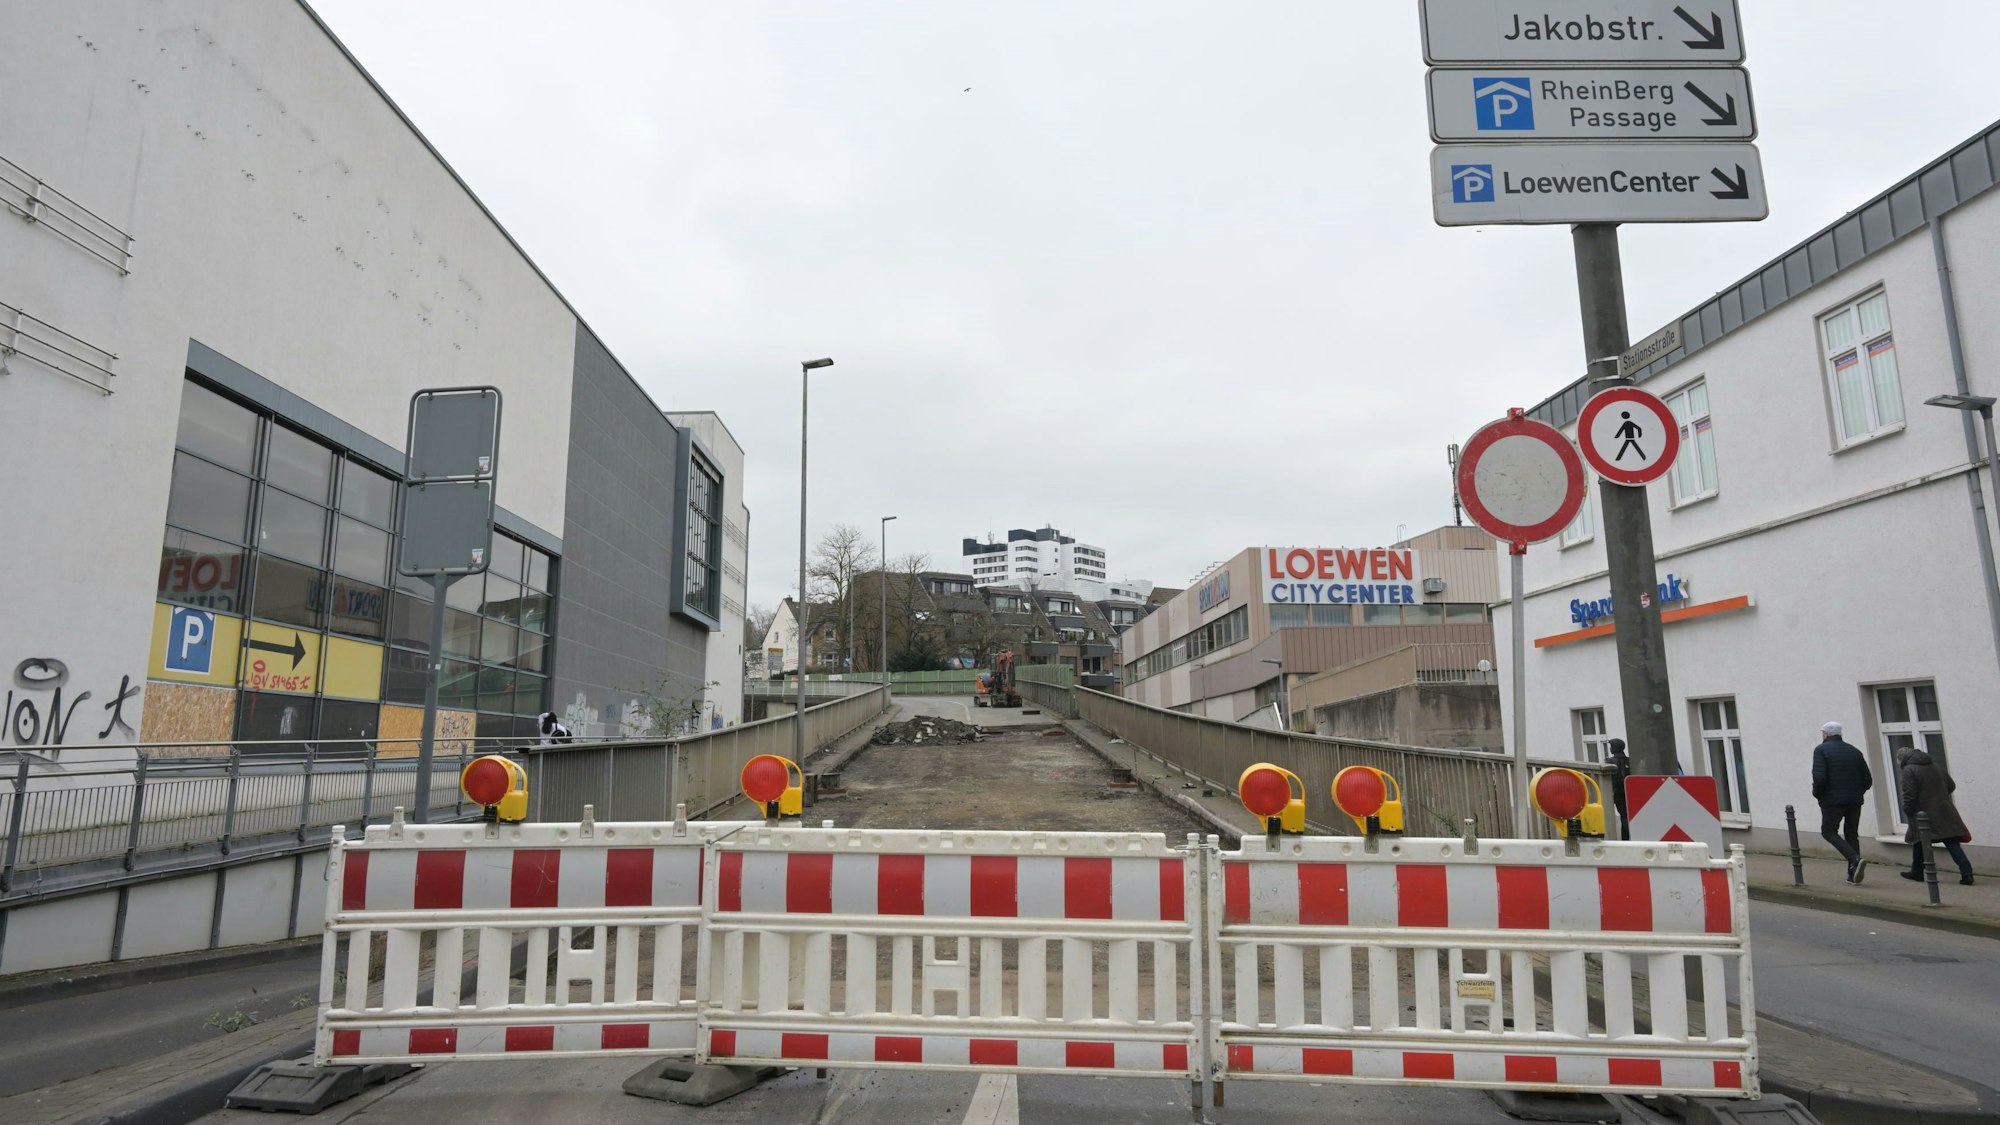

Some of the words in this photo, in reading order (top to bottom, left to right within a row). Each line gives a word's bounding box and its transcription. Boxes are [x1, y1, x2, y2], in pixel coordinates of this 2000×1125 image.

[1503, 14, 1664, 41] Jakobstr.
[1541, 80, 1675, 105] RheinBerg
[1570, 107, 1678, 132] Passage
[1503, 170, 1700, 195] LoewenCenter
[1623, 330, 1676, 371] Stationsstraße
[1268, 548, 1413, 580] LOEWEN
